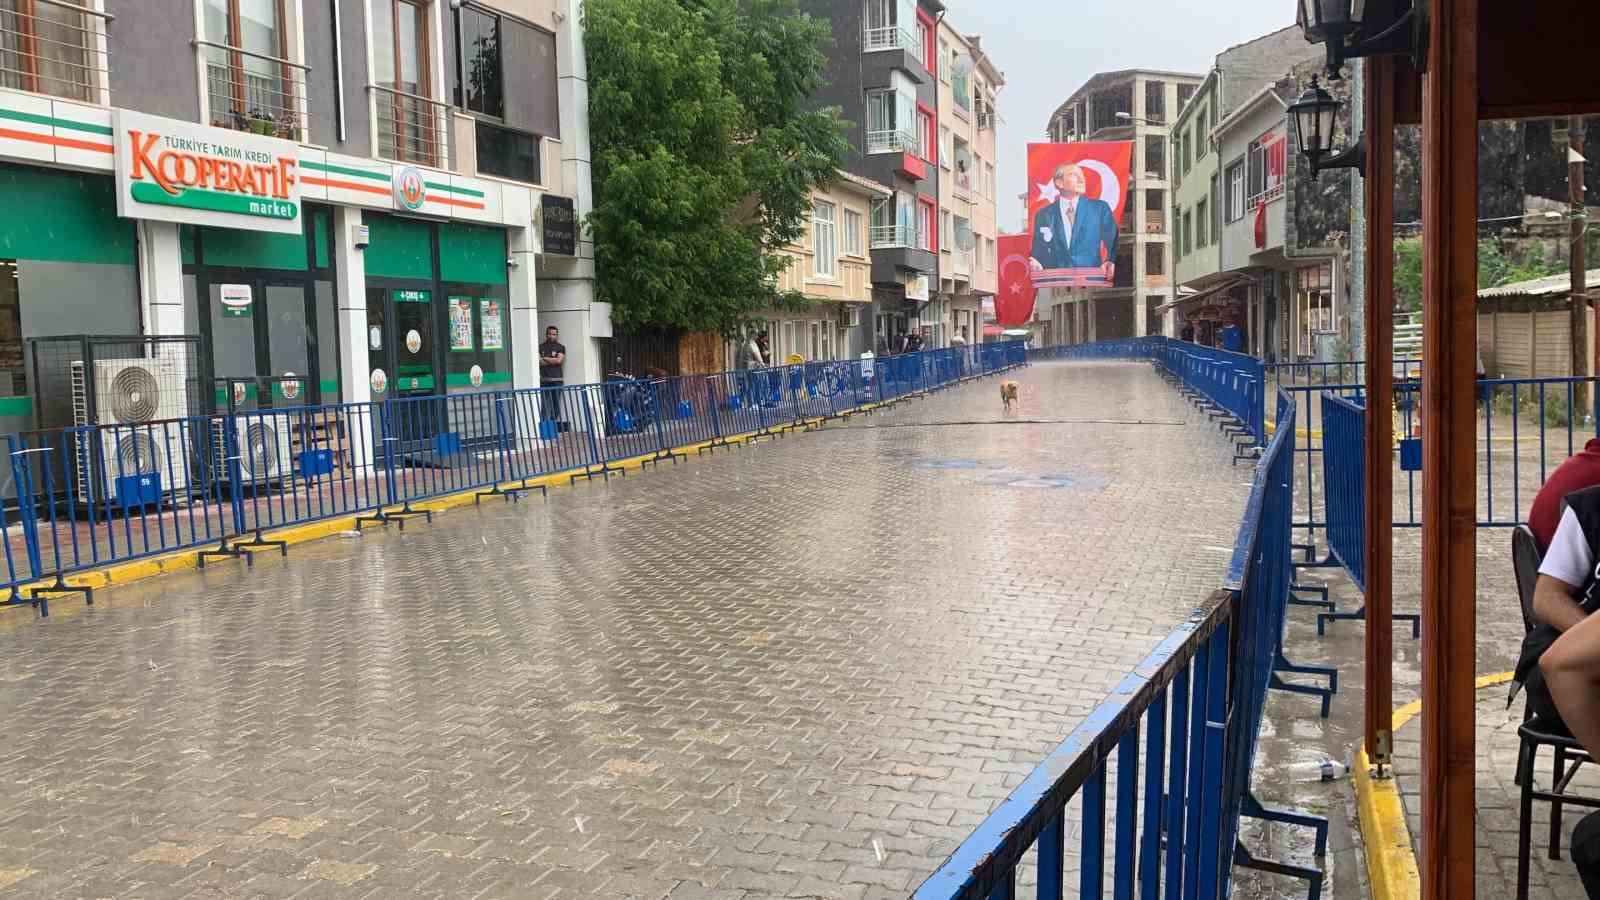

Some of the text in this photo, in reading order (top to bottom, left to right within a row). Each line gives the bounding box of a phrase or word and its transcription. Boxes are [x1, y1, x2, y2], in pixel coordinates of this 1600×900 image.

[164, 134, 272, 164] TÜRKİYE TARIM KREDİ
[250, 200, 292, 217] market
